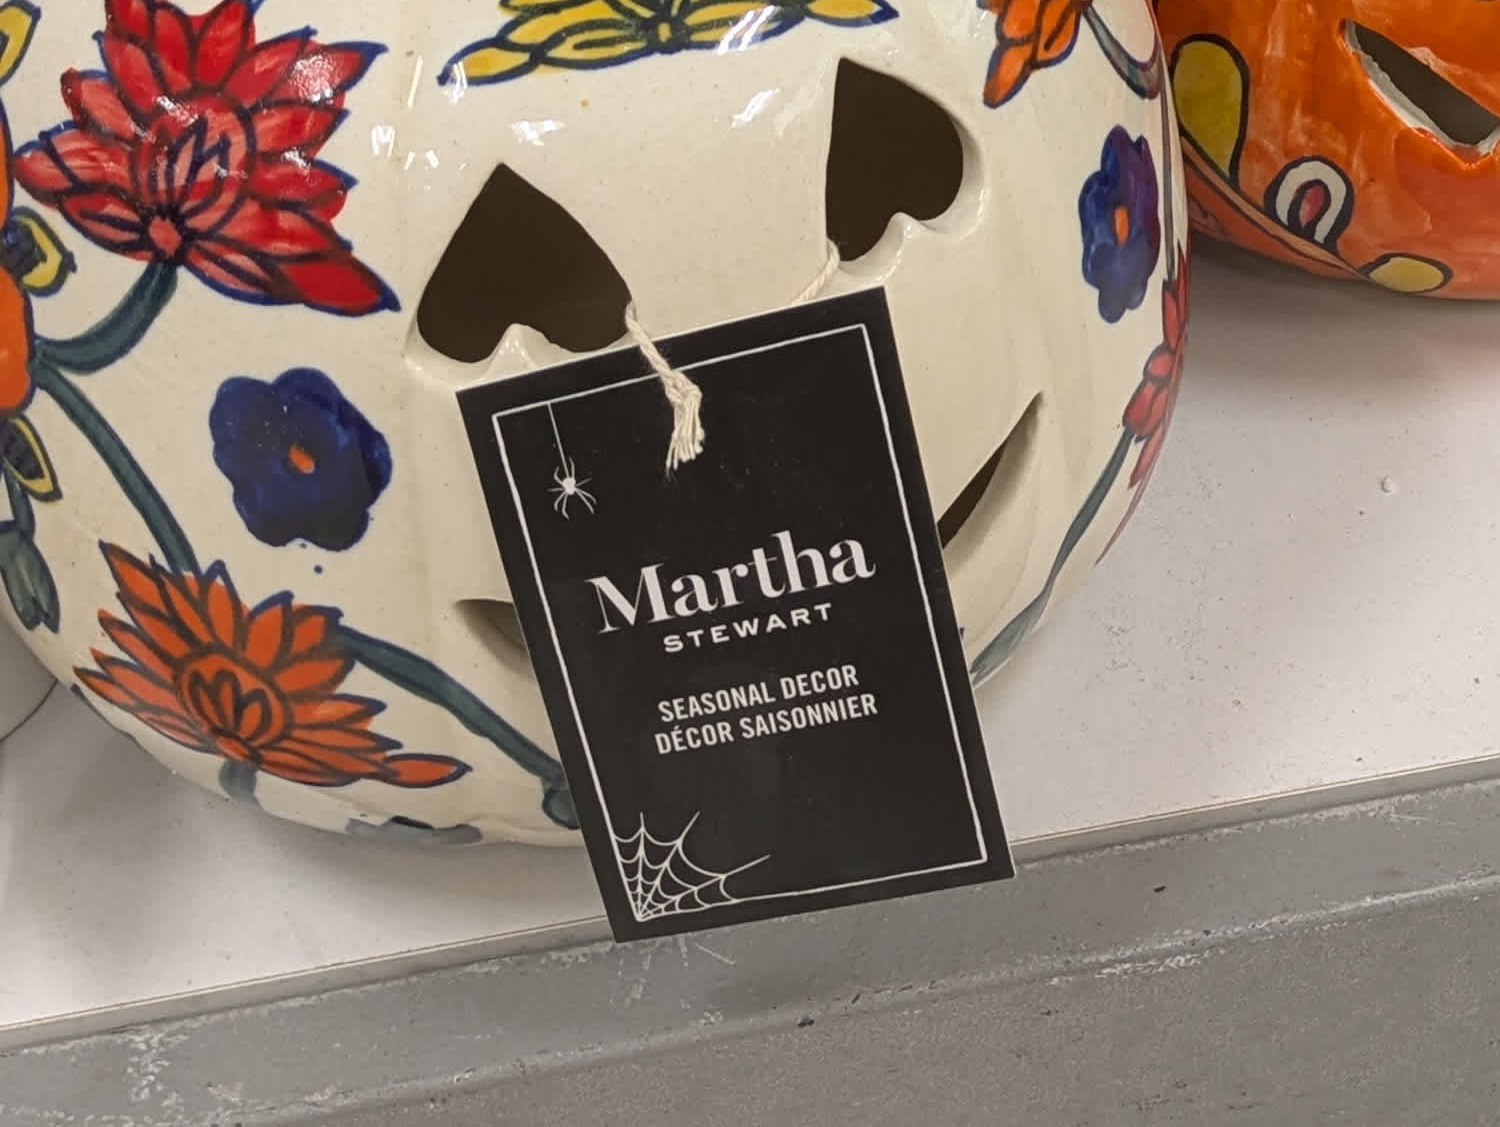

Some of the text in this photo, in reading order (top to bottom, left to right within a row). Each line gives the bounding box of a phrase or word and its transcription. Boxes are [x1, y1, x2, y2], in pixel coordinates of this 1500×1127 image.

[584, 530, 876, 633] Martha
[663, 602, 832, 653] STEWART
[658, 664, 859, 722] SEASONAL DECOR
[655, 693, 877, 754] DÉCOR SAISONNIER
